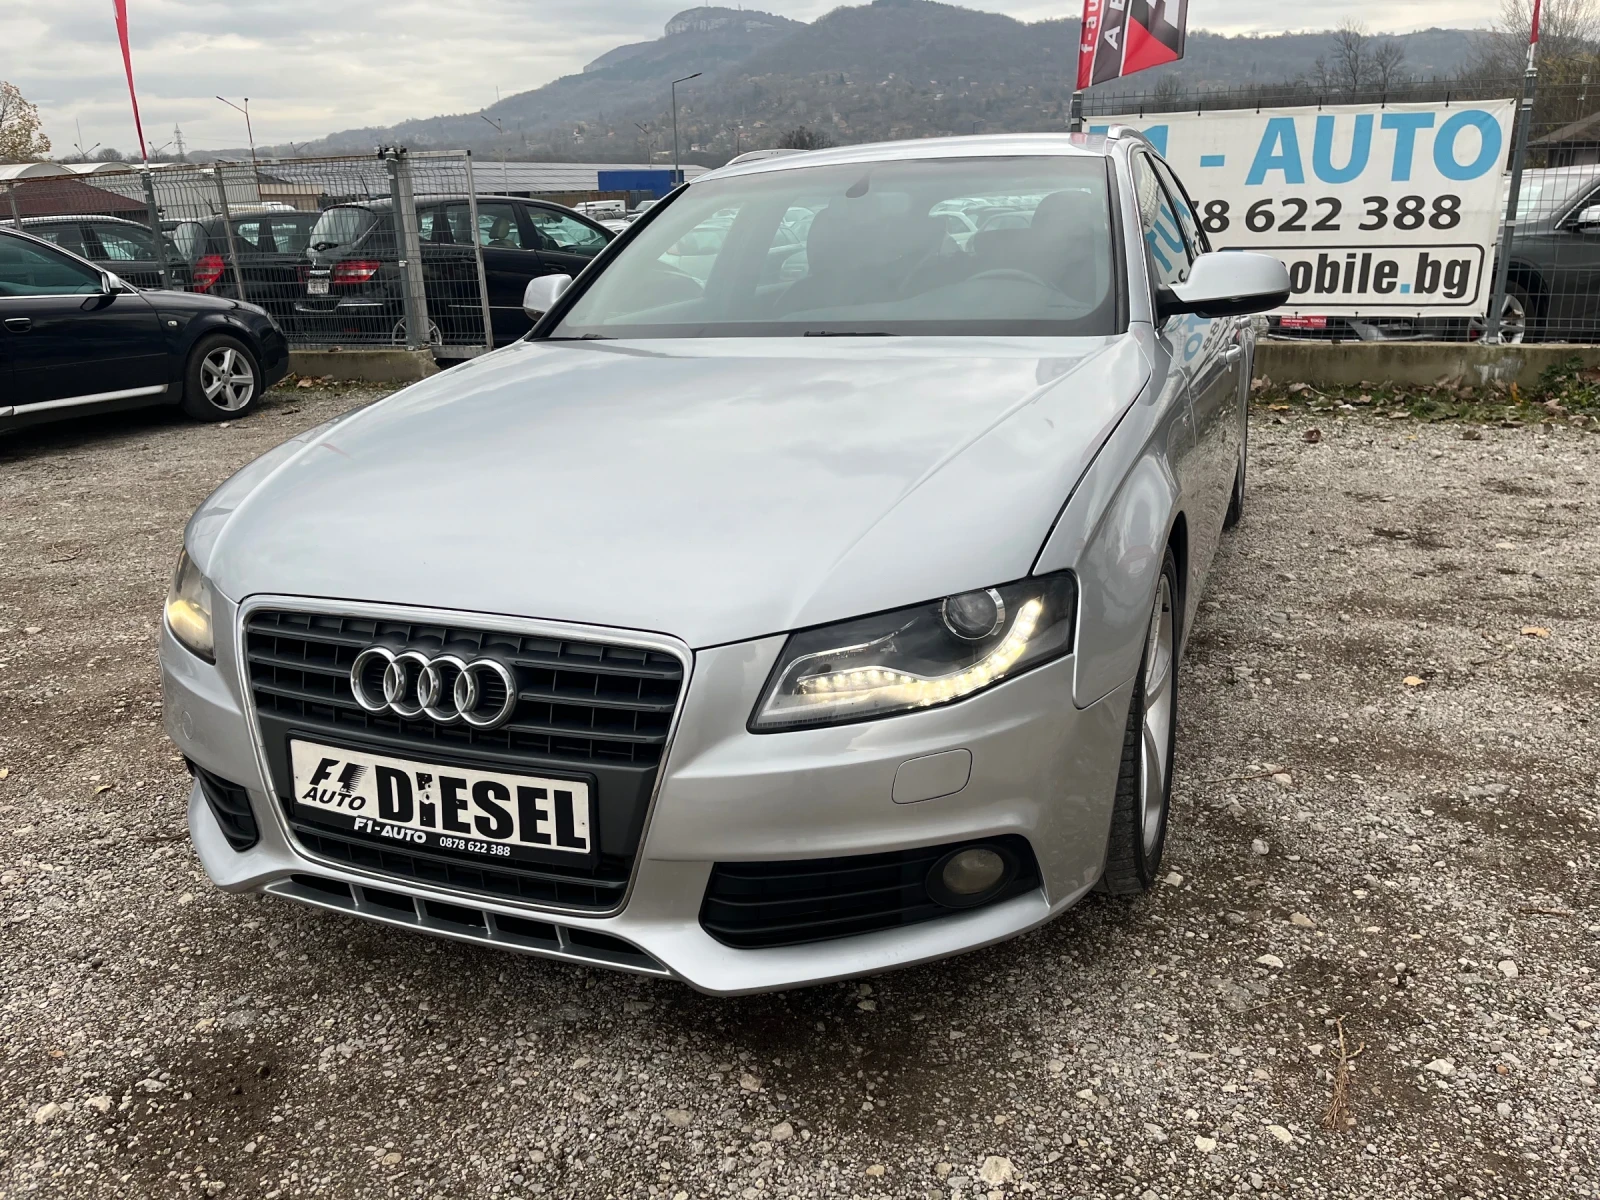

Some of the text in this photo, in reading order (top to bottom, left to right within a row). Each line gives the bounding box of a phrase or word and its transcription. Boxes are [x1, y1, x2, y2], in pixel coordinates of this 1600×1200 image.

[1245, 110, 1502, 185] AUTO
[1245, 197, 1342, 232] 622
[1358, 194, 1461, 231] 388
[1282, 252, 1472, 299] obile.bg
[302, 786, 366, 811] AUTO
[309, 757, 587, 850] F1 DIESEL
[354, 817, 511, 857] F1-AUTO 0878 622 388
